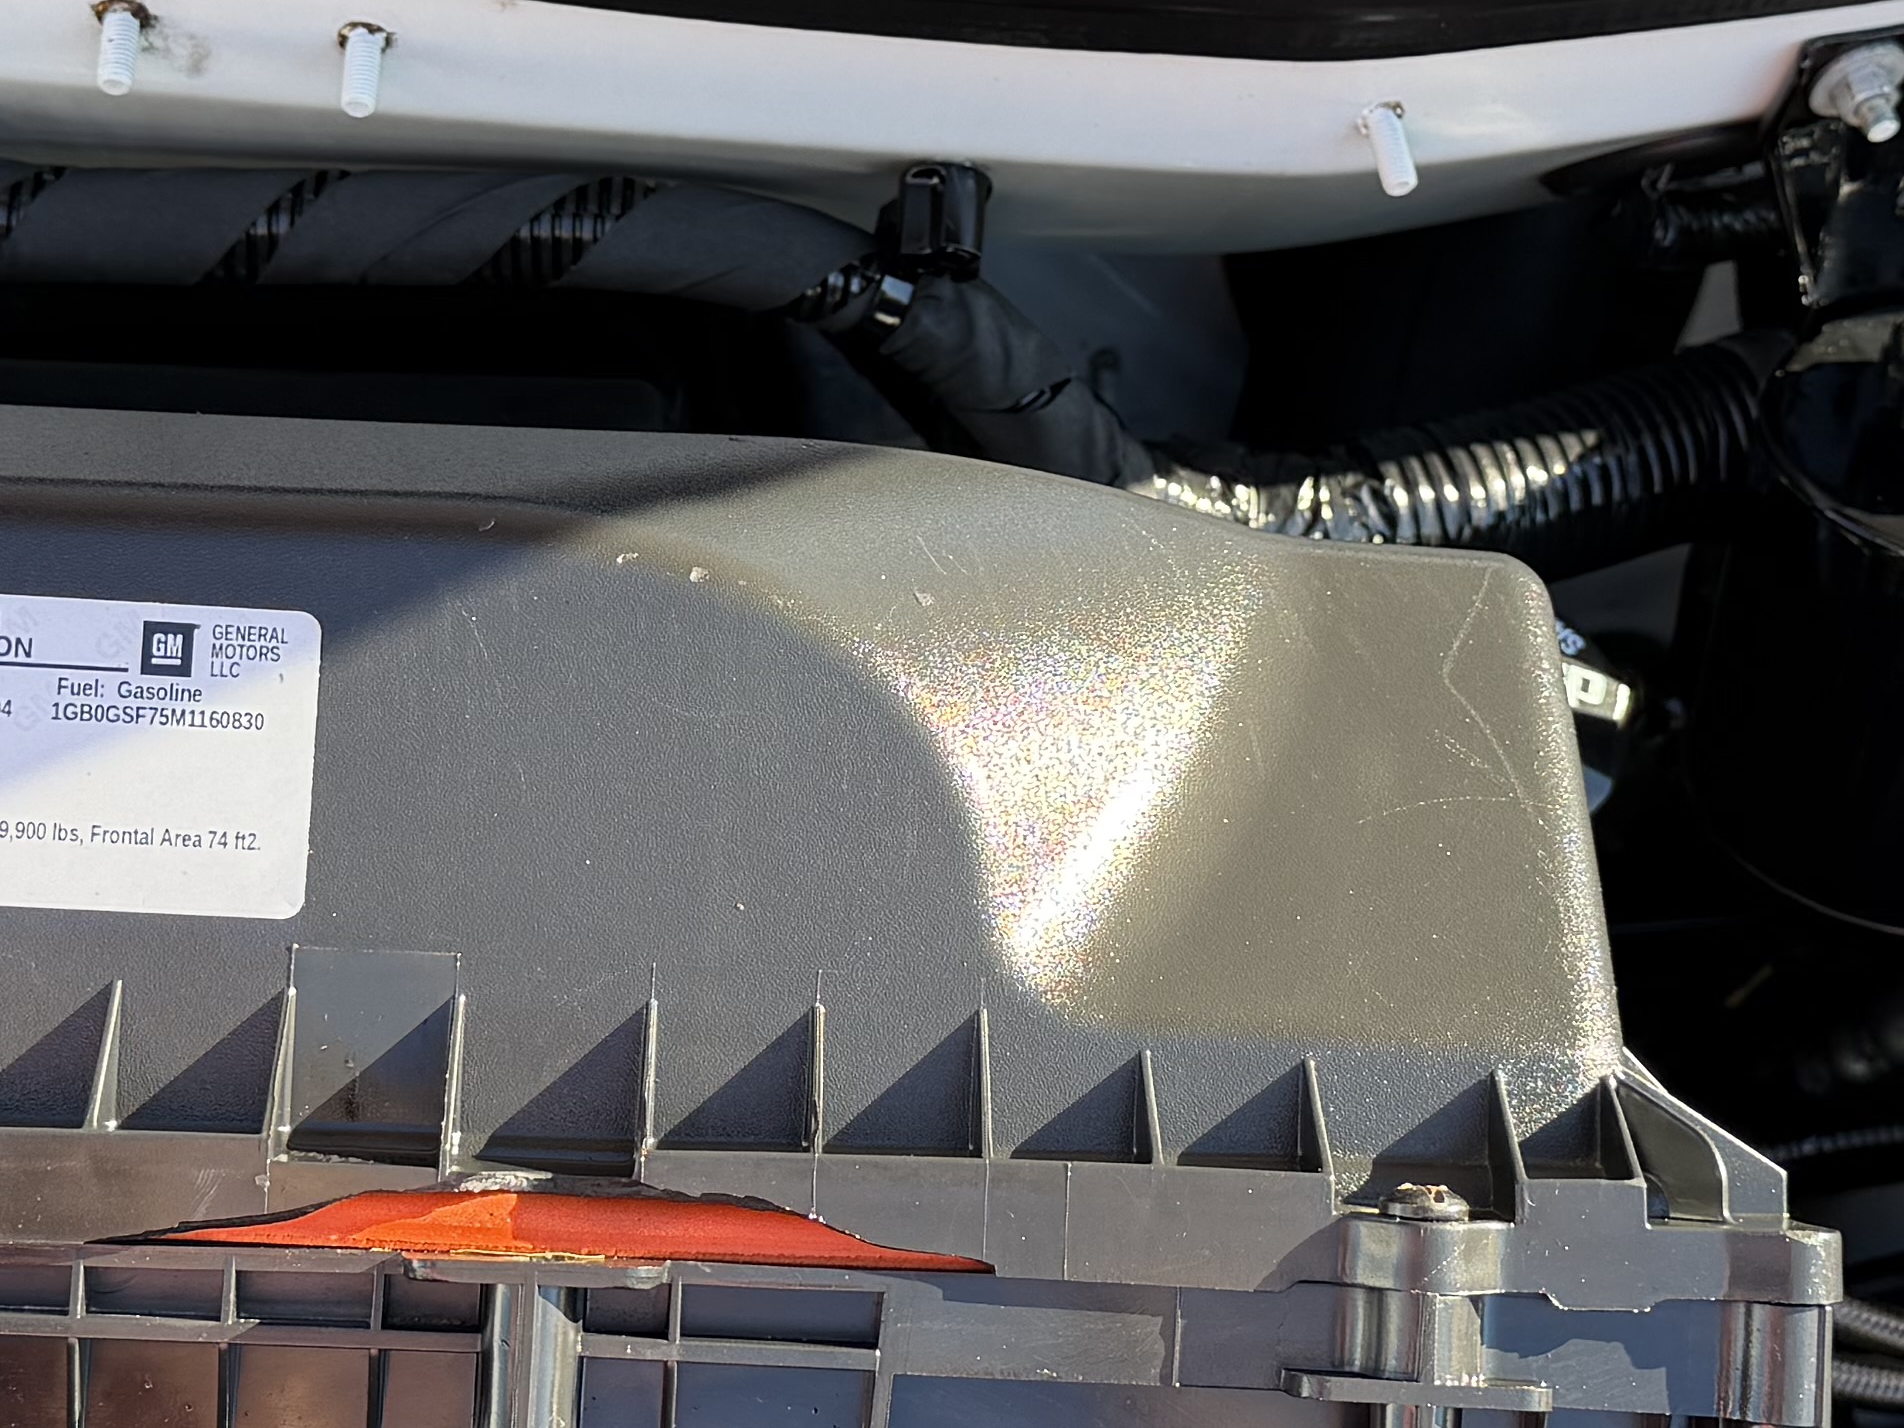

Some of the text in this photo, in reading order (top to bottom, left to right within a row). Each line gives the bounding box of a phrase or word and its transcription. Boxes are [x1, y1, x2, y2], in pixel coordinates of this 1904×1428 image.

[152, 632, 184, 659] GM
[211, 623, 289, 645] GENERAL
[210, 642, 282, 663] MOTORS
[209, 660, 242, 679] LLC
[56, 676, 203, 703] Fuel: Gasoline
[50, 701, 265, 731] 1GB0GSF75M1160830
[52, 822, 84, 846] lbs,
[90, 824, 155, 846] Frontal
[159, 828, 203, 849] Area
[208, 830, 229, 850] 74
[234, 830, 261, 851] ft2.
